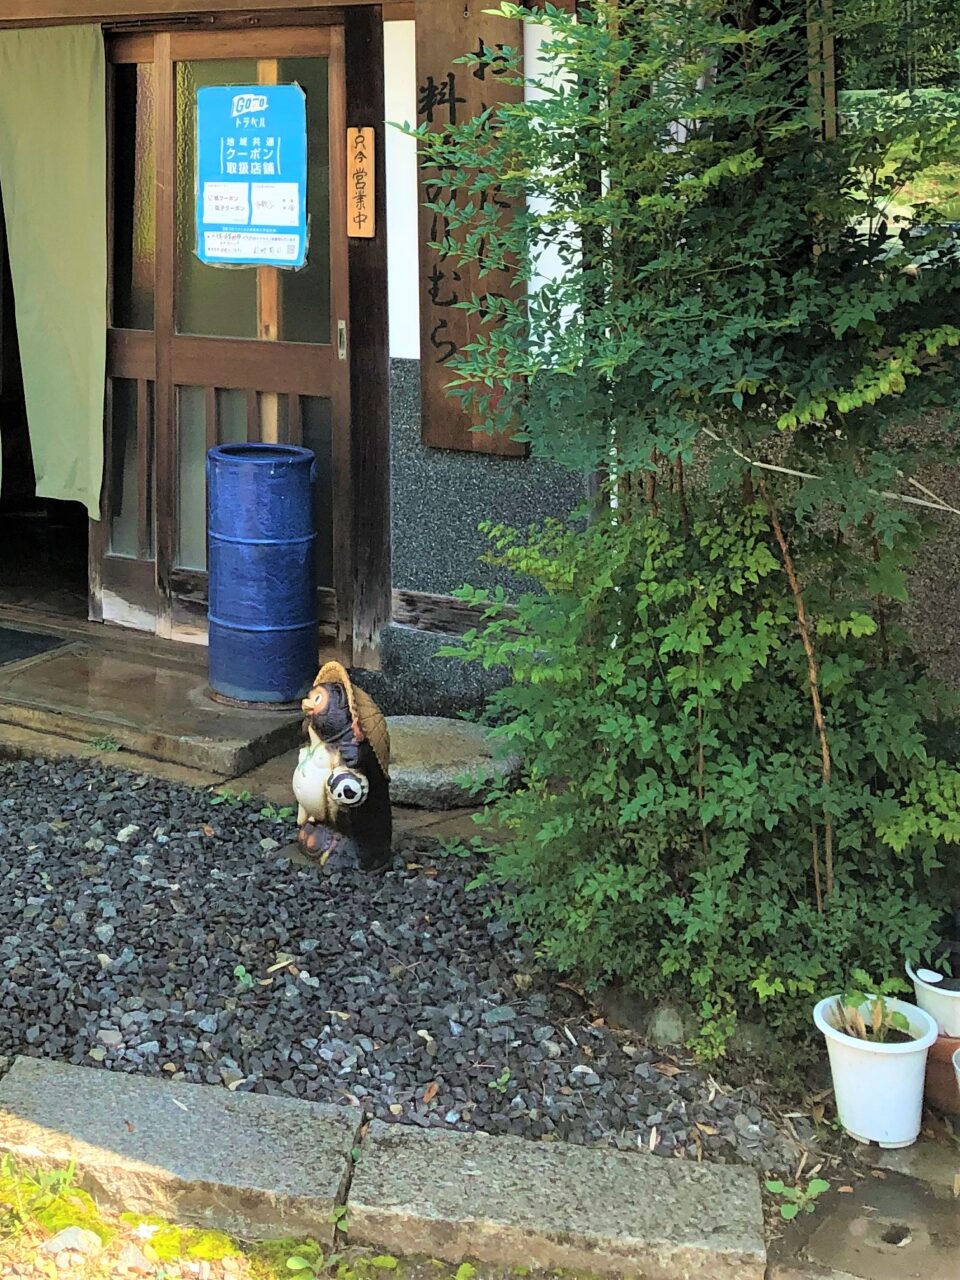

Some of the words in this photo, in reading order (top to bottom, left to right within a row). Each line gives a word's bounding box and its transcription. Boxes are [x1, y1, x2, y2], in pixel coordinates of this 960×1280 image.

[235, 117, 266, 129] トラベル
[226, 137, 275, 147] 地域共通
[226, 148, 274, 160] クーポン
[226, 161, 275, 175] 取扱店舗
[353, 135, 368, 230] 只今営業中
